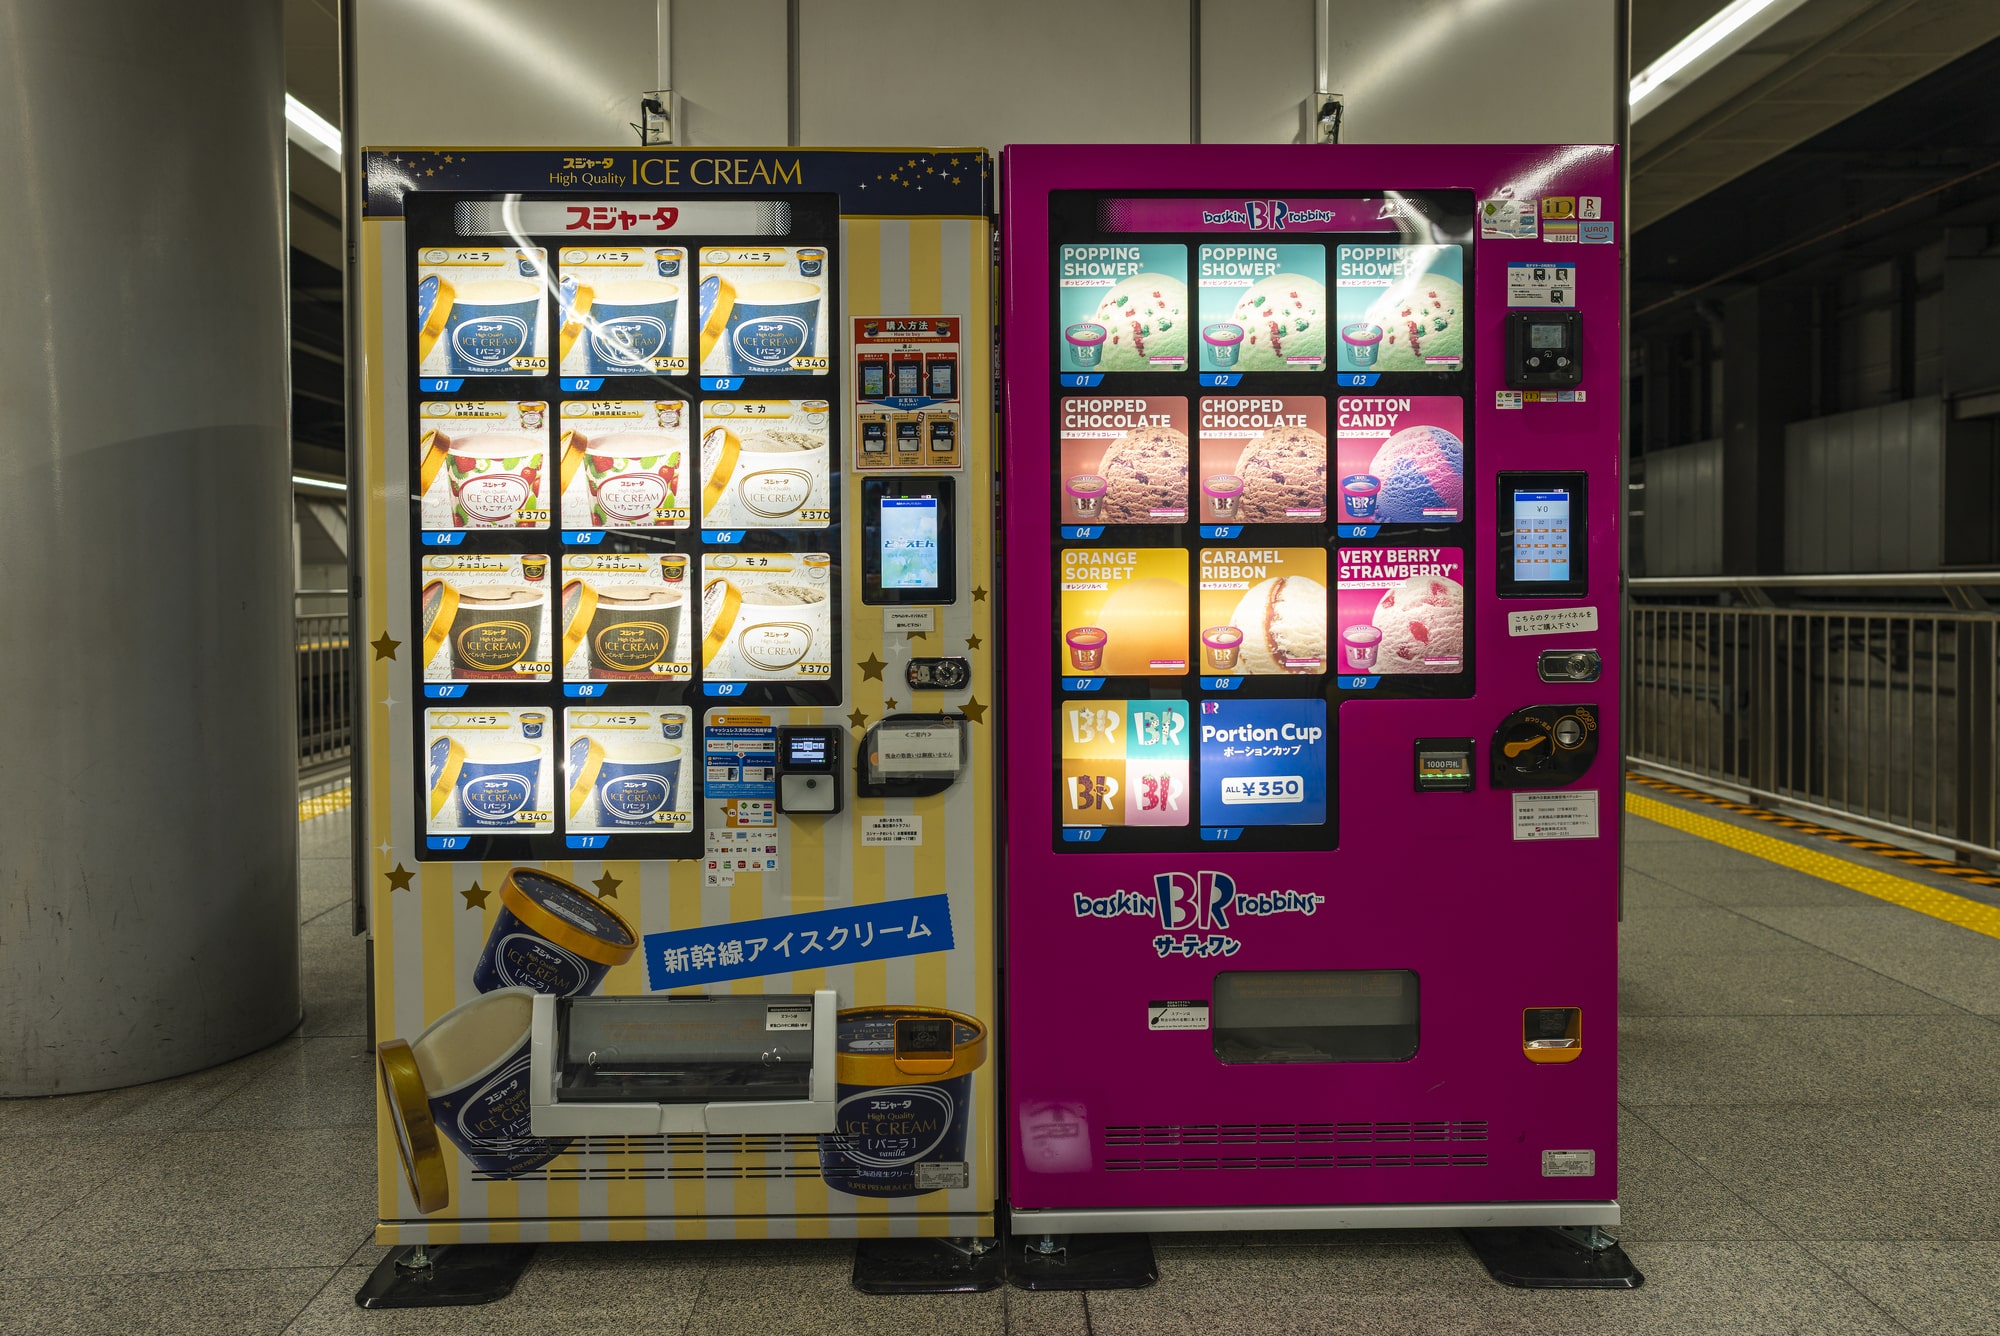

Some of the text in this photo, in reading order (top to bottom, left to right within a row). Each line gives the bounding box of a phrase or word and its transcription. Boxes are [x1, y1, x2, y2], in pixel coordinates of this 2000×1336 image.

[563, 157, 614, 169] スジャータ
[632, 158, 802, 186] ICE CREAM
[549, 172, 626, 188] High Quality
[1545, 200, 1573, 215] iD
[566, 206, 679, 230] スジャータ
[1245, 199, 1288, 231] BR
[457, 252, 490, 262] バニラ
[596, 252, 629, 262] バニラ
[738, 252, 771, 262] バニラ
[1064, 247, 1140, 261] POPPING
[1202, 247, 1278, 261] POPPING
[886, 321, 929, 331] 購入方法
[463, 336, 517, 347] ICE CREAM
[743, 336, 798, 347] ICE CREAM
[516, 359, 546, 368] ¥340
[654, 359, 685, 368] ¥340
[796, 359, 826, 368] ¥340
[436, 381, 449, 391] 01
[576, 380, 590, 391] 02
[716, 379, 730, 390] 03
[1076, 375, 1090, 386] 01
[1214, 375, 1229, 386] 02
[1353, 375, 1367, 386] 03
[455, 401, 486, 410] いちご
[592, 400, 623, 410] いちご
[744, 404, 766, 414] モカ
[1065, 399, 1147, 413] CHOPPED
[1202, 399, 1283, 413] CHOPPED
[1339, 398, 1411, 412] COTTON
[1065, 414, 1171, 428] CHOCOLATE
[1202, 414, 1308, 428] CHOCOLATE
[1339, 414, 1399, 428] CANDY
[467, 493, 521, 504] ICE CREAM
[605, 493, 659, 503] ICE CREAM
[750, 493, 801, 503] ICE CREAM
[475, 504, 512, 512] いちごアイス
[656, 509, 686, 518] ¥370
[518, 511, 547, 520] ¥370
[801, 511, 830, 520] ¥370
[1076, 527, 1091, 538] 04
[1214, 527, 1229, 537] 05
[1353, 526, 1367, 537] 06
[437, 533, 452, 544] 04
[576, 533, 591, 543] 05
[716, 532, 731, 543] 06
[745, 557, 768, 567] モカ
[1065, 551, 1137, 565] ORANGE
[1202, 550, 1284, 564] CARAMEL
[1340, 549, 1441, 564] VERY BERRY
[1065, 566, 1134, 580] SORBET
[1202, 565, 1267, 579] RIBBON
[1515, 611, 1592, 623] こちらのタッチパネルを
[1515, 622, 1579, 633] 押してご購入下さい
[467, 641, 521, 651] ICE CREAM
[605, 641, 659, 652] ICE CREAM
[750, 646, 801, 656] ICE CREAM
[519, 663, 551, 672] ¥400
[657, 664, 688, 673] ¥400
[801, 664, 830, 673] ¥370
[1076, 679, 1091, 690] 07
[1215, 678, 1230, 689] 08
[1353, 677, 1367, 688] 09
[438, 686, 454, 696] 07
[578, 685, 593, 696] 08
[718, 684, 733, 695] 09
[467, 716, 497, 725] バニラ
[607, 716, 637, 725] バニラ
[1133, 710, 1185, 746] BR
[1202, 723, 1322, 744] Portion Cup
[1223, 745, 1302, 757] ポーションカップ
[1427, 759, 1460, 769] 1000円札
[1067, 775, 1119, 810] BR
[1242, 780, 1299, 796] ¥350
[471, 793, 522, 803] ICE CREAM
[610, 793, 661, 802] ICE CREAM
[520, 813, 547, 821] ¥340
[659, 813, 686, 821] ¥340
[1078, 830, 1091, 840] 10
[1216, 829, 1229, 839] 11
[442, 838, 456, 848] 10
[581, 836, 594, 847] 11
[1073, 889, 1156, 918] baskin
[1153, 870, 1237, 931] BR
[663, 915, 932, 974] 新幹線アイスクリーム
[1153, 934, 1242, 959] サーティワン
[525, 950, 540, 963] High
[507, 947, 570, 990] ICE CREAM
[489, 1100, 506, 1115] High
[870, 1099, 912, 1110] スジャータ
[474, 1098, 531, 1133] ICE CRE
[867, 1111, 915, 1122] High Quality
[845, 1118, 937, 1136] ICE CREAM
[879, 1149, 906, 1158] vanilla
